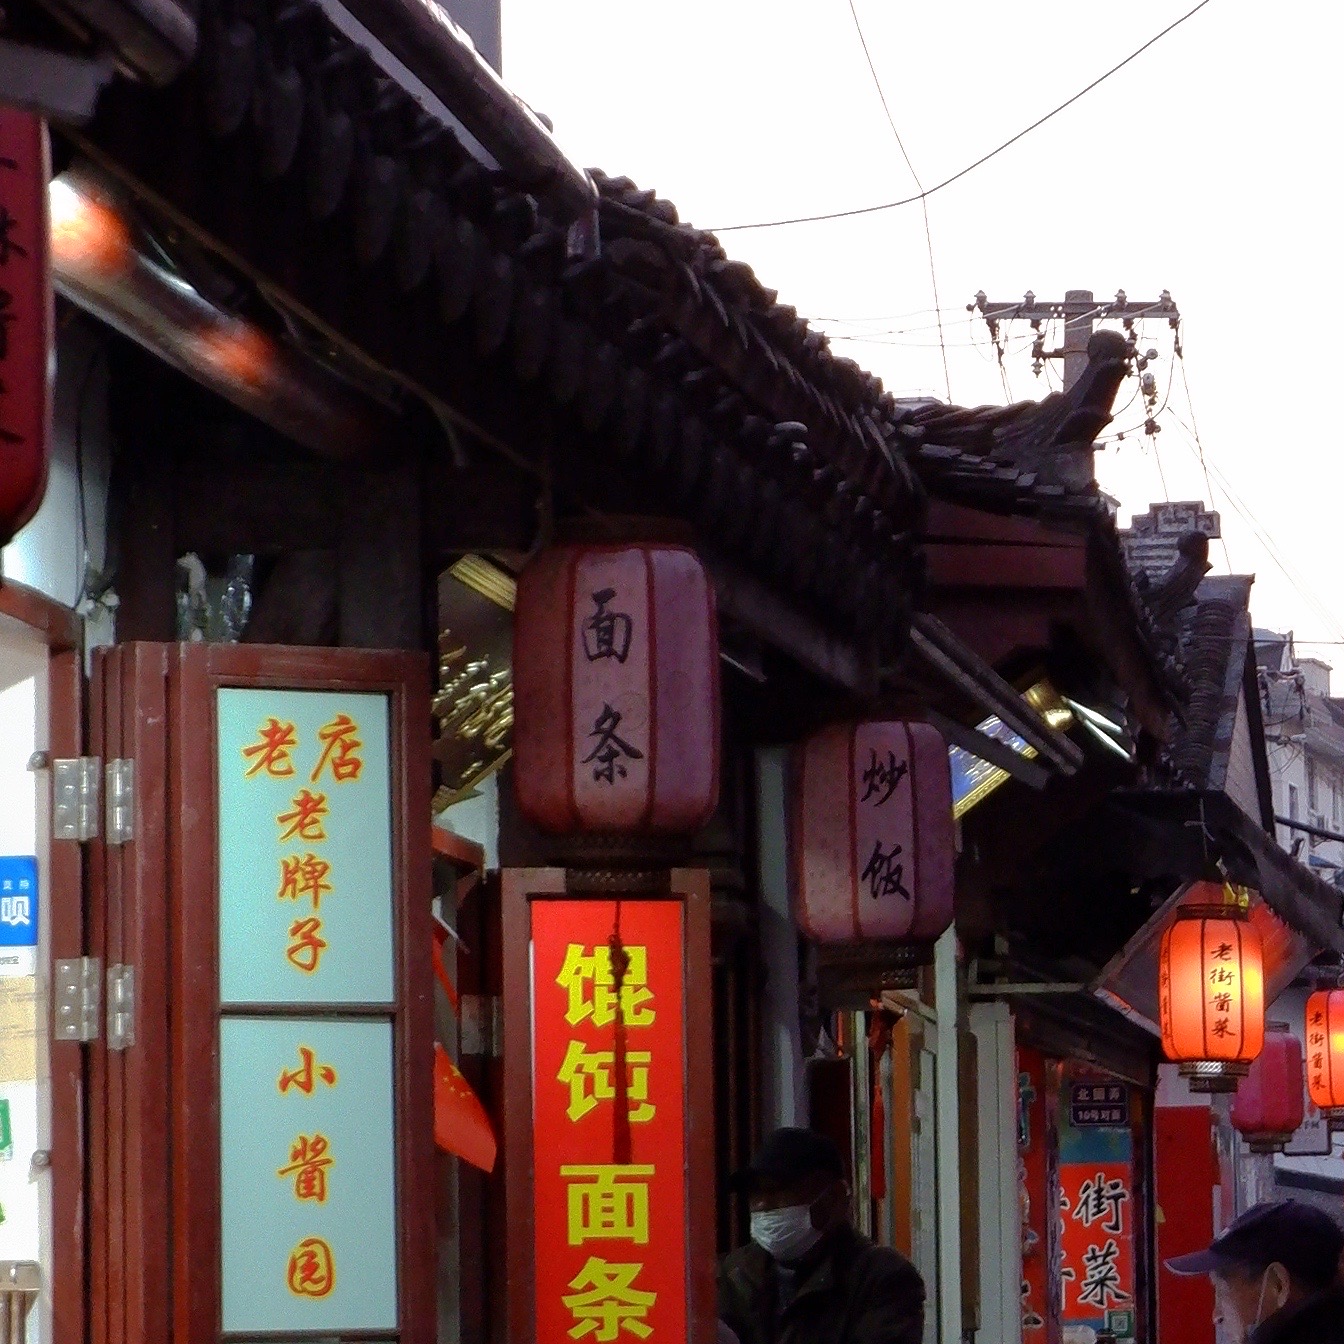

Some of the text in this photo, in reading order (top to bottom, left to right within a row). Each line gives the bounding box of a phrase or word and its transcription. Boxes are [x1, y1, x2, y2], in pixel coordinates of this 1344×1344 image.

[242, 714, 364, 783] 老店
[581, 587, 644, 785] 面条
[276, 789, 333, 973] 老牌子
[861, 747, 911, 902] 炒饭
[1208, 942, 1236, 1038] 老街酱菜
[276, 1047, 337, 1298] 小酱园
[1060, 1172, 1130, 1233] 街
[1060, 1243, 1132, 1310] 菜
